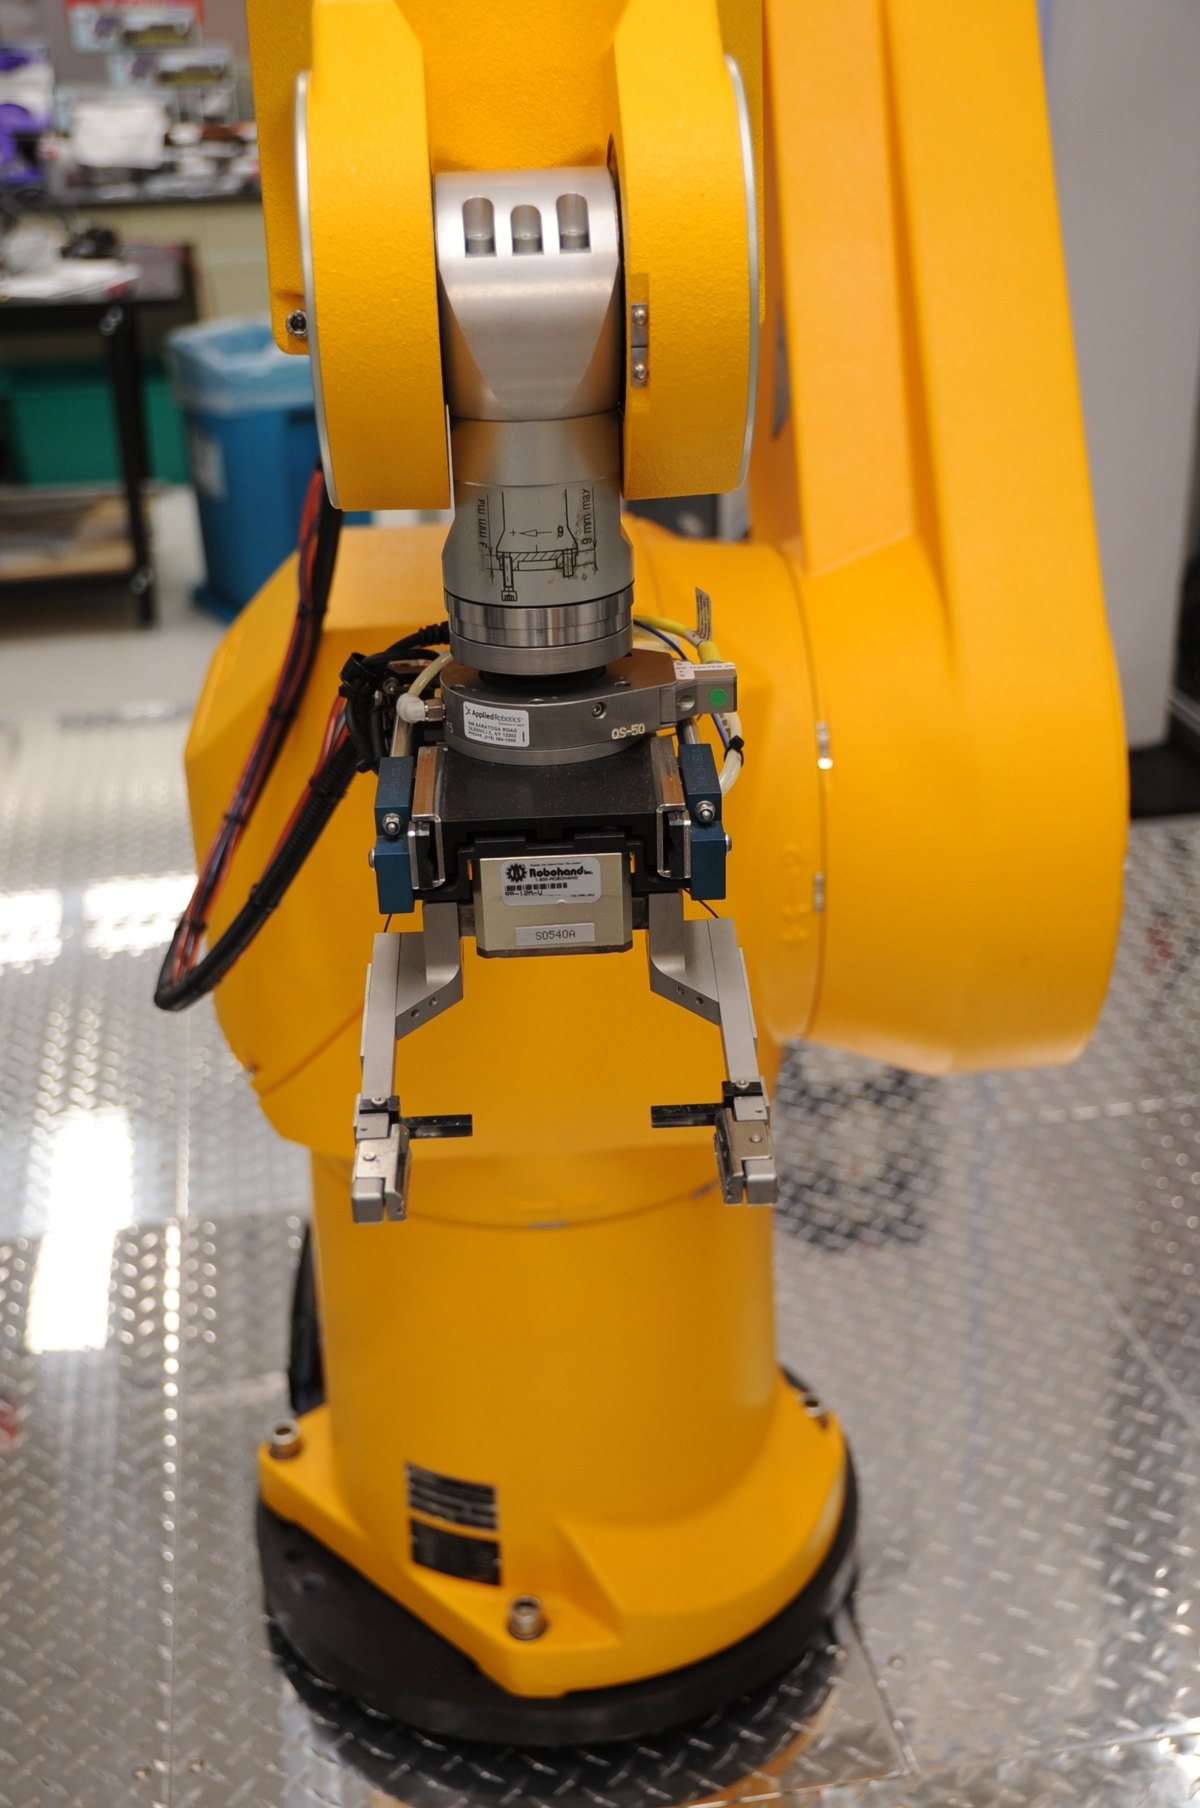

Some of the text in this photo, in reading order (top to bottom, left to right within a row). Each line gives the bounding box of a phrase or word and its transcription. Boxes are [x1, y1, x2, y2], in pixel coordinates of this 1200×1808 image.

[582, 488, 591, 509] max
[583, 511, 592, 534] mm
[529, 866, 583, 878] Robohand
